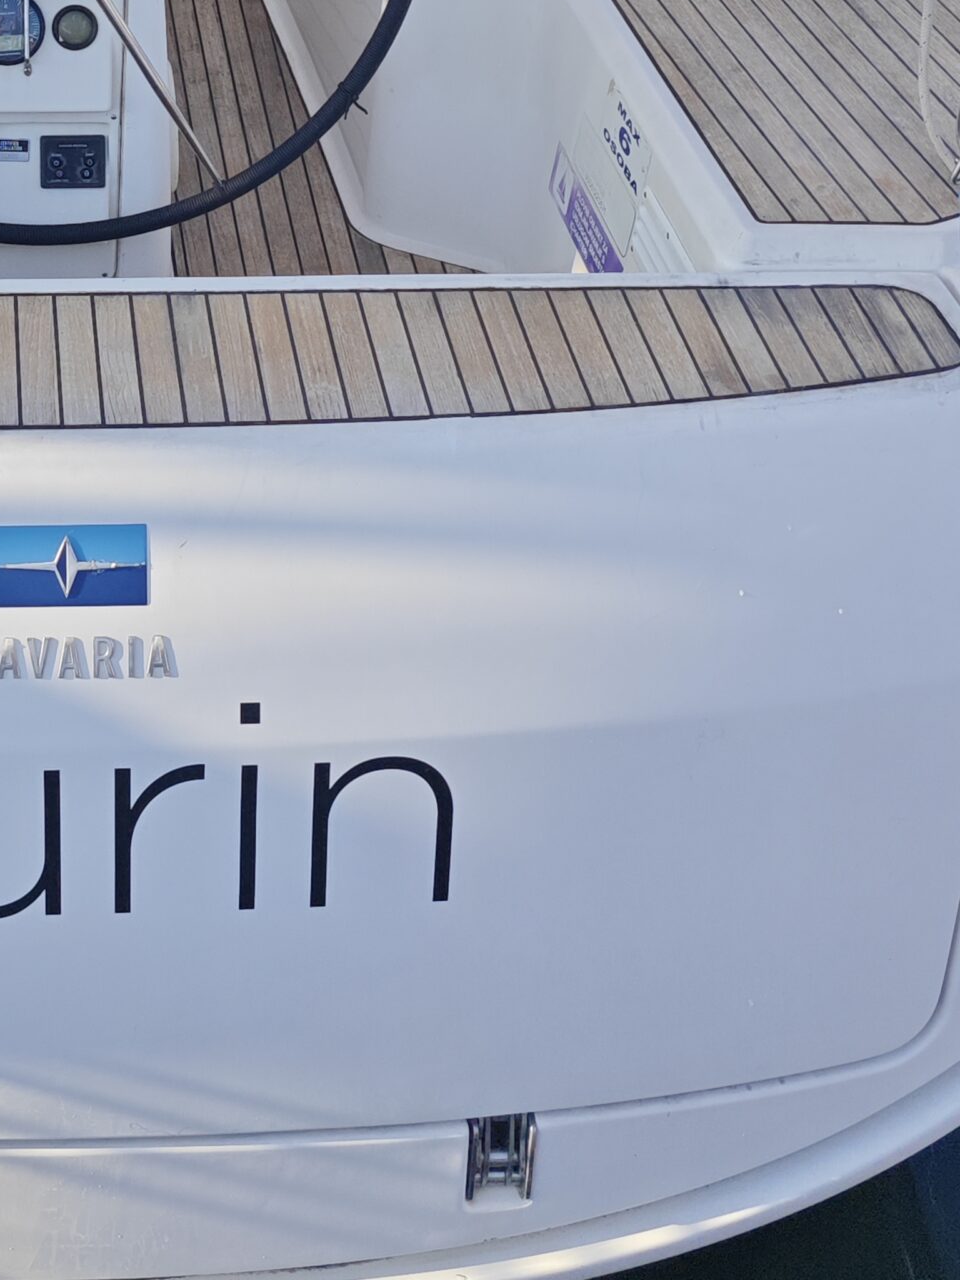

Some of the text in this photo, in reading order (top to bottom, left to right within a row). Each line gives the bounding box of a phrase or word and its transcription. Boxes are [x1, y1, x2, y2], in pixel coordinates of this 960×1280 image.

[617, 101, 640, 147] MAX
[619, 126, 632, 157] 6
[603, 127, 637, 196] OSOBA
